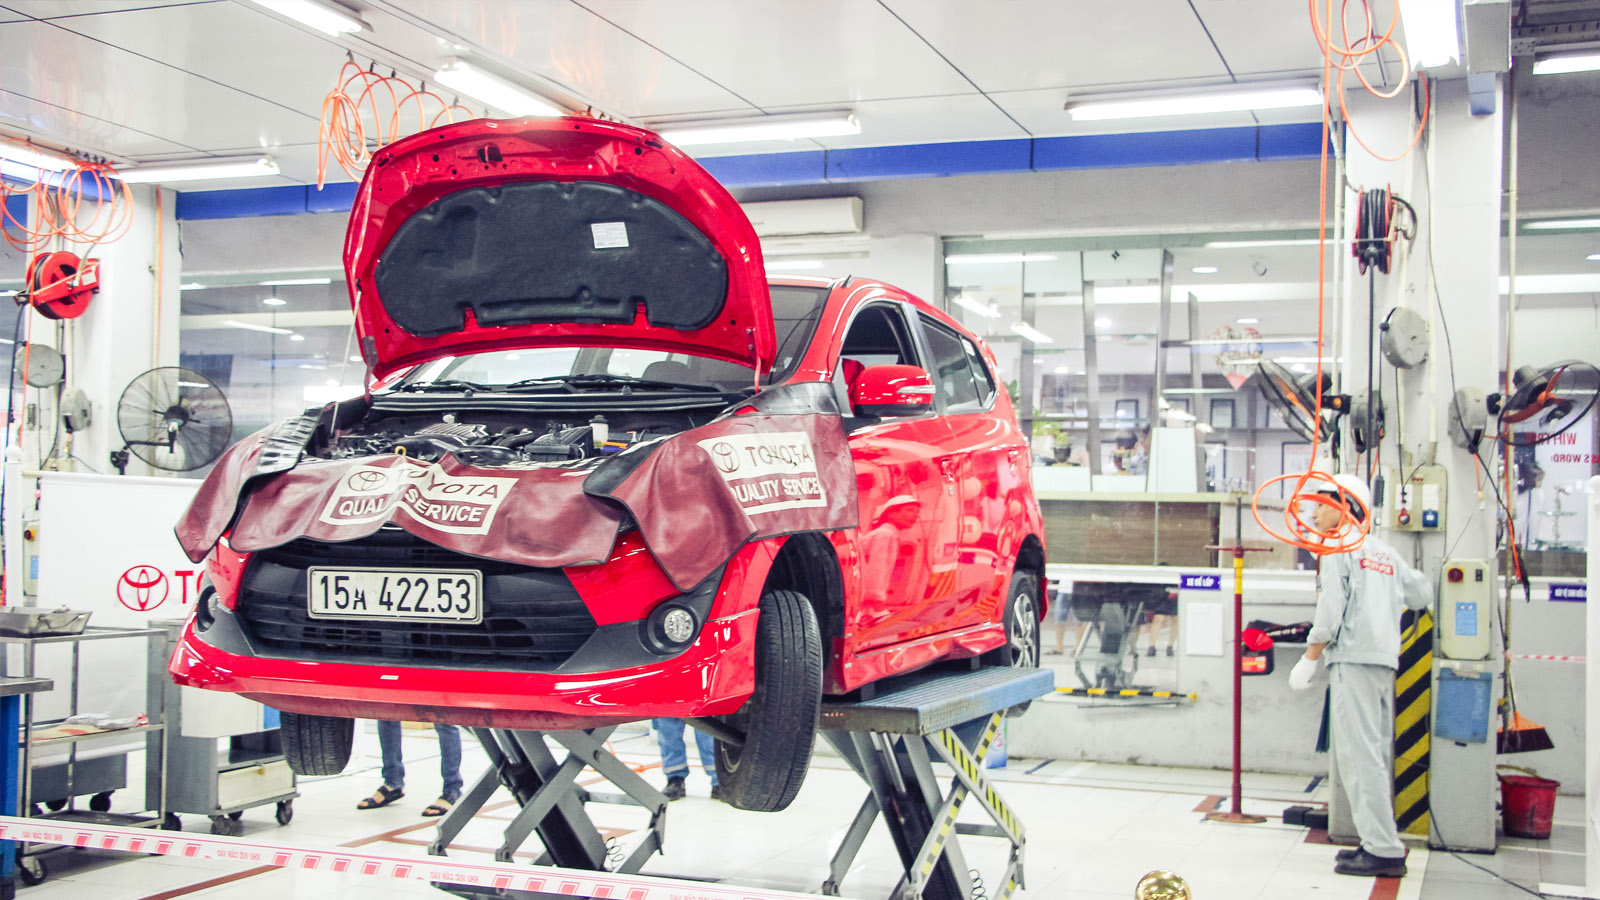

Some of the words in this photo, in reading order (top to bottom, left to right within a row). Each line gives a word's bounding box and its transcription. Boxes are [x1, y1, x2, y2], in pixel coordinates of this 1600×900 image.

[744, 444, 813, 467] TOYOTA
[405, 488, 485, 522] SERVICE
[378, 576, 471, 614] 422.53
